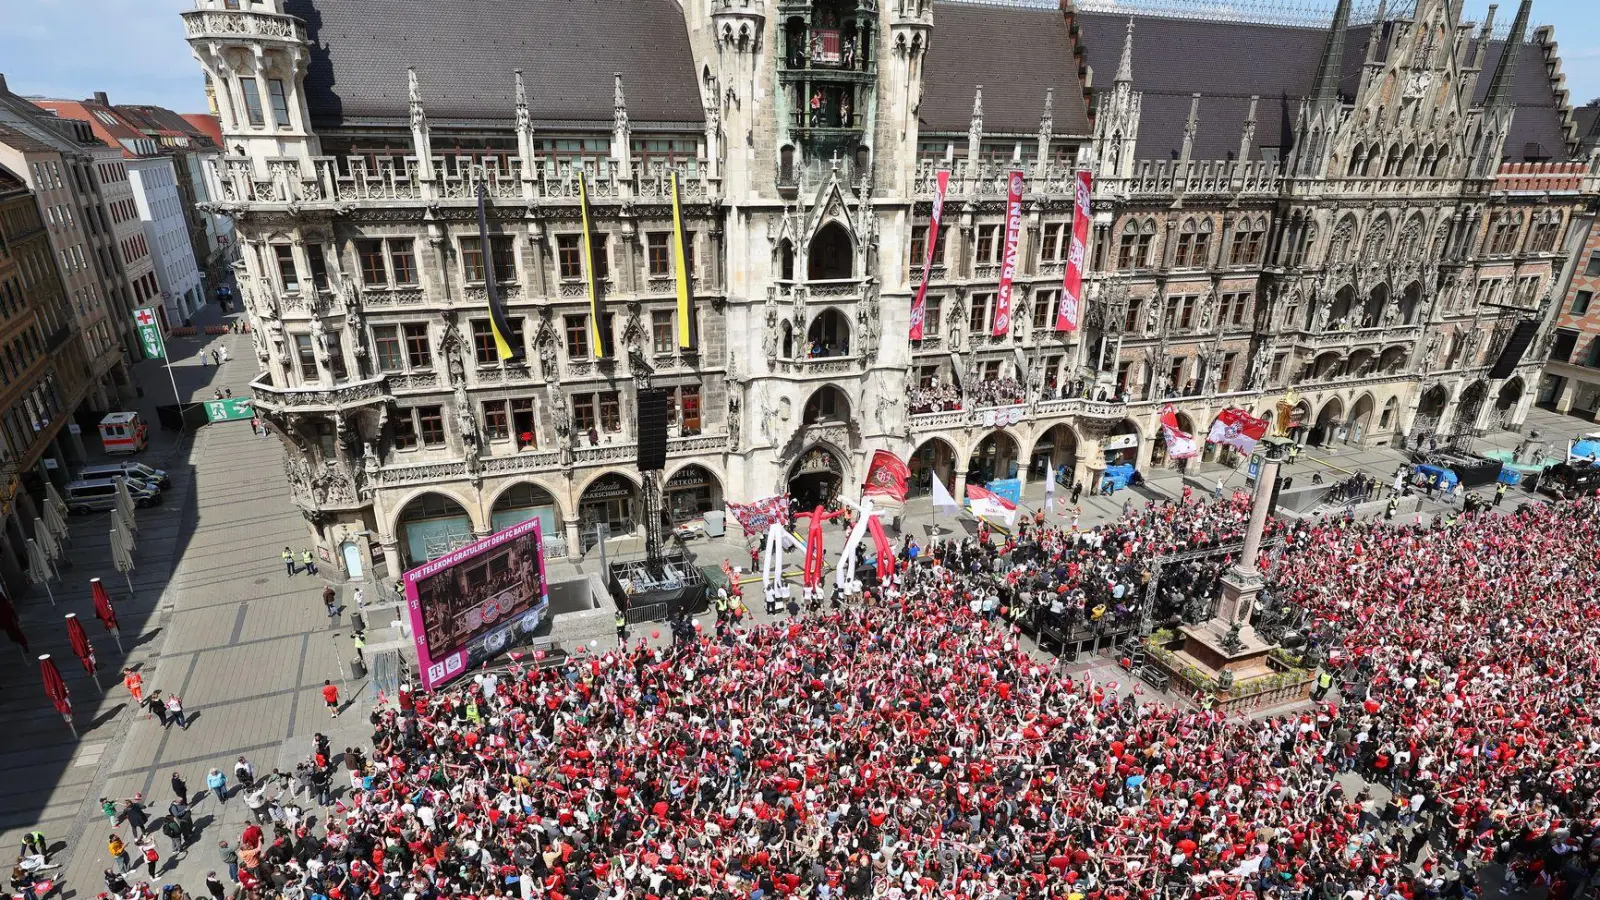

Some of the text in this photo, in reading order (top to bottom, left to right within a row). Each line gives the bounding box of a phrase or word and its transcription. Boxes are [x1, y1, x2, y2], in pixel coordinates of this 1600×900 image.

[1003, 202, 1022, 279] BAYERN
[1253, 455, 1258, 463] S
[1251, 465, 1256, 473] U
[409, 520, 537, 581] DIE TELEKOM GRATULIERT DEM FC BAYERN!
[431, 664, 442, 679] T
